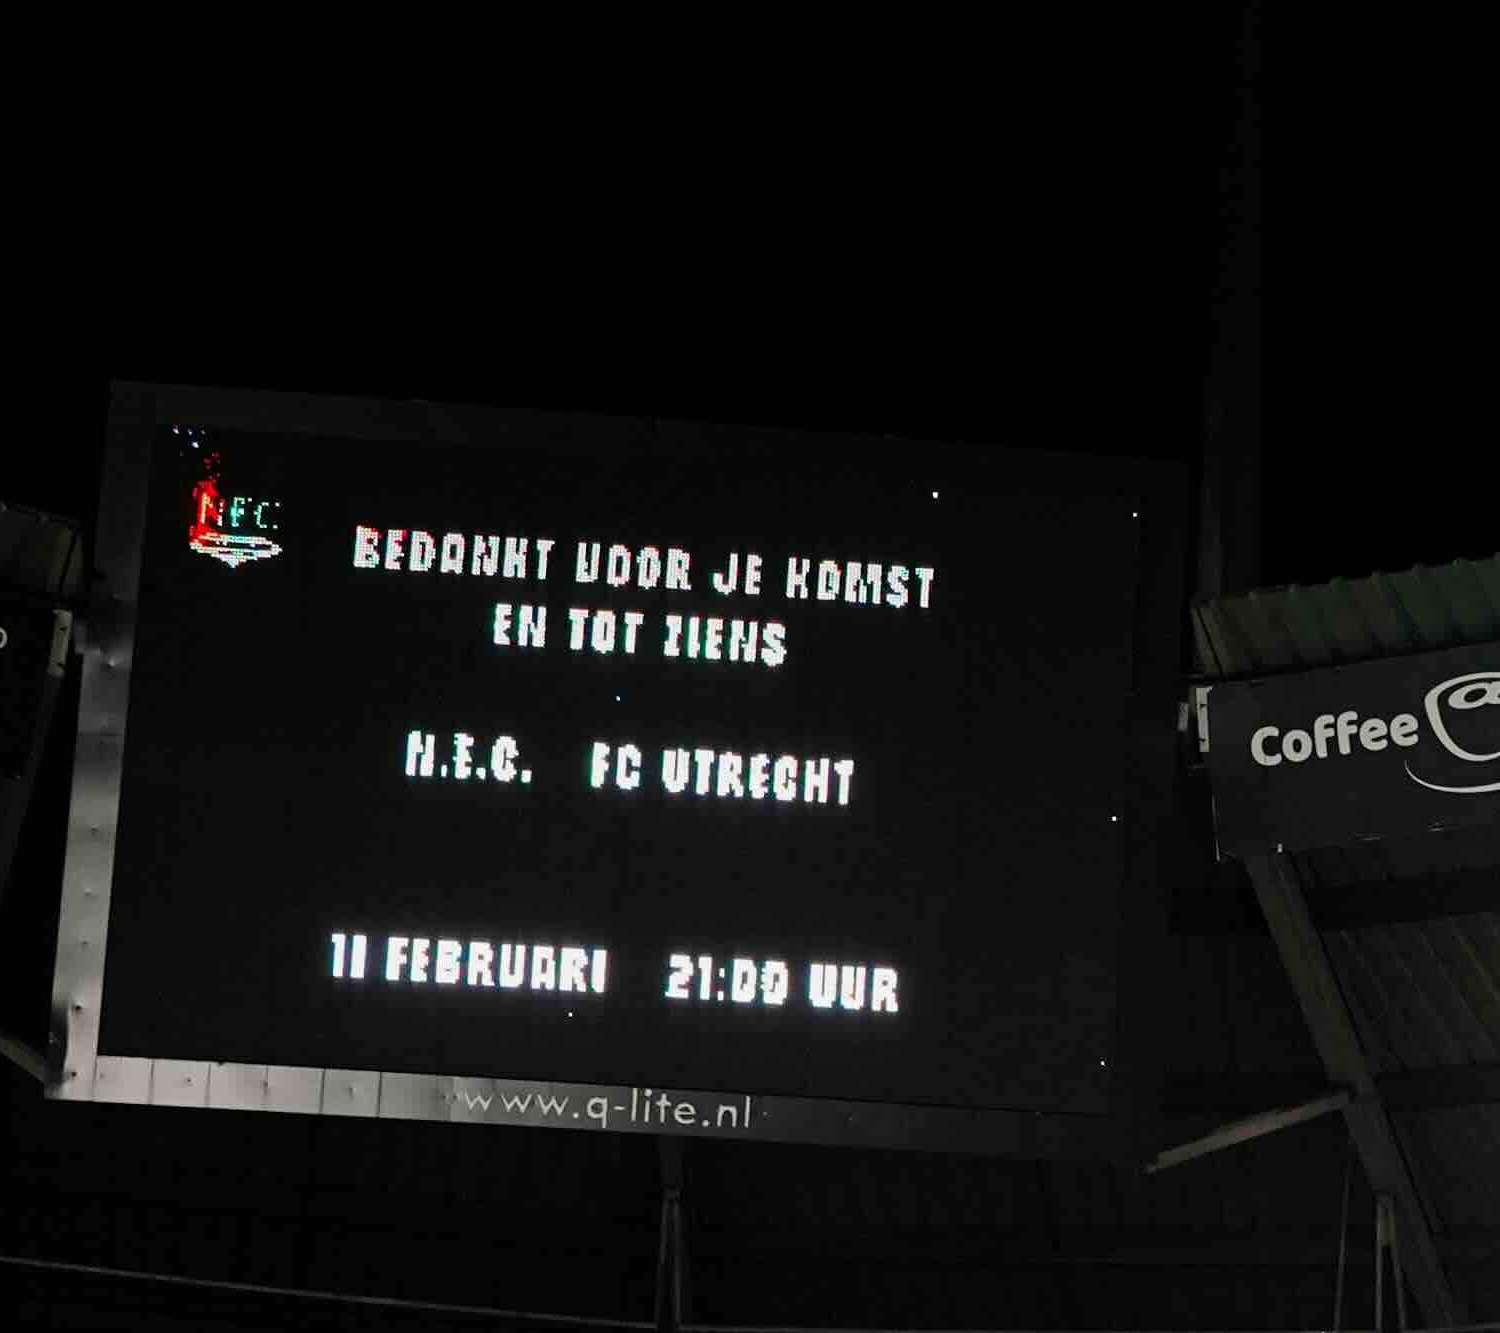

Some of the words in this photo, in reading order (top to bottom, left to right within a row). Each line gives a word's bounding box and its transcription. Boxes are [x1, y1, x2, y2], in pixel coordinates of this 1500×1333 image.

[354, 525, 555, 582] BEDANKT
[574, 540, 693, 592] VOOR
[712, 553, 763, 597] JE
[786, 558, 935, 607] KOMST
[494, 604, 547, 647] EN
[569, 608, 645, 655] TOT
[664, 615, 788, 667] ZIENS
[406, 731, 533, 784] N.E.C.
[591, 742, 642, 791] FC
[662, 748, 855, 806] UTRECHT
[1249, 709, 1421, 772] Coffee
[332, 933, 368, 980] 11
[386, 937, 608, 994] FEBRUARI
[665, 953, 789, 1006] 21:00
[808, 964, 899, 1012] UUR
[438, 1082, 753, 1132] www.q-lite.nl
